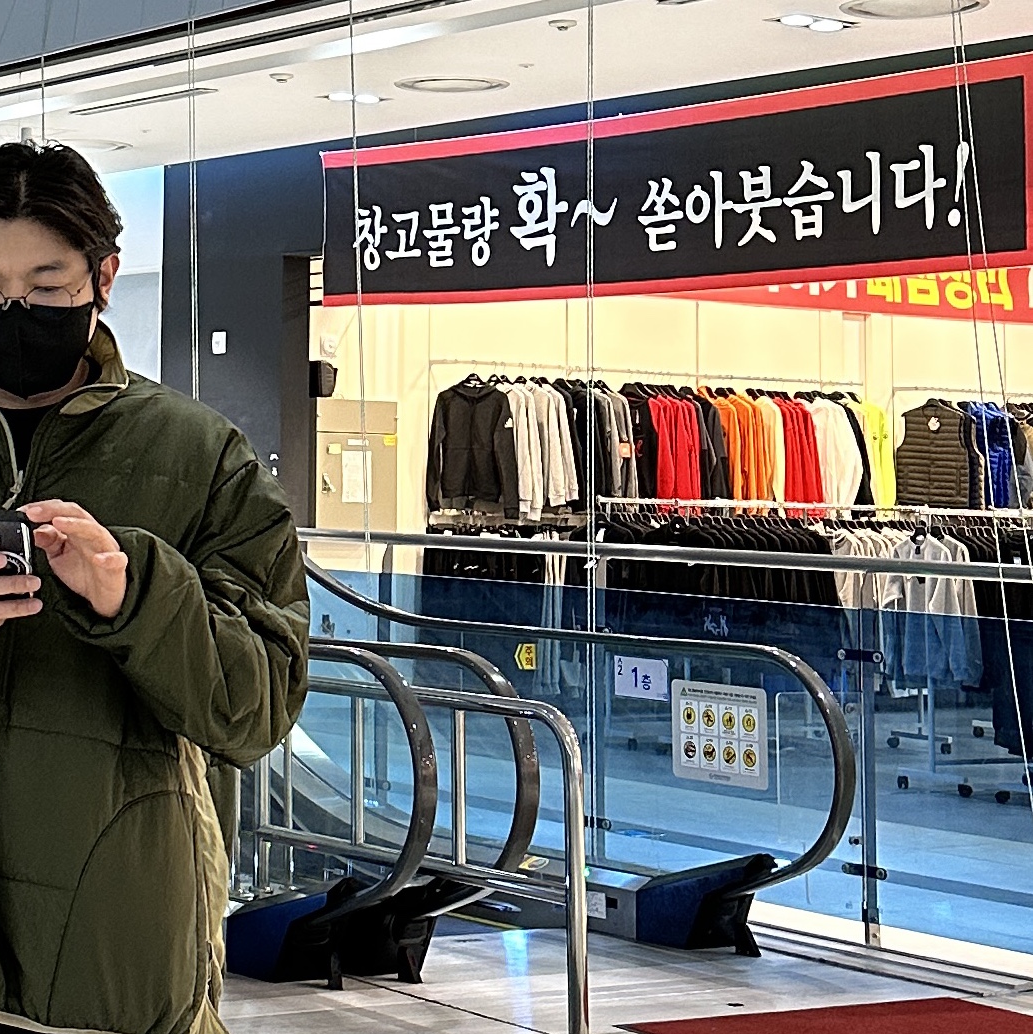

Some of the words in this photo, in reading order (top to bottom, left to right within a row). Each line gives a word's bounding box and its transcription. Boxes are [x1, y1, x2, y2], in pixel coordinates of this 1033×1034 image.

[353, 196, 499, 271] 창고물량
[638, 141, 969, 252] 쏟아붓습니다!
[525, 645, 534, 667] 주의
[631, 666, 653, 691] 1층
